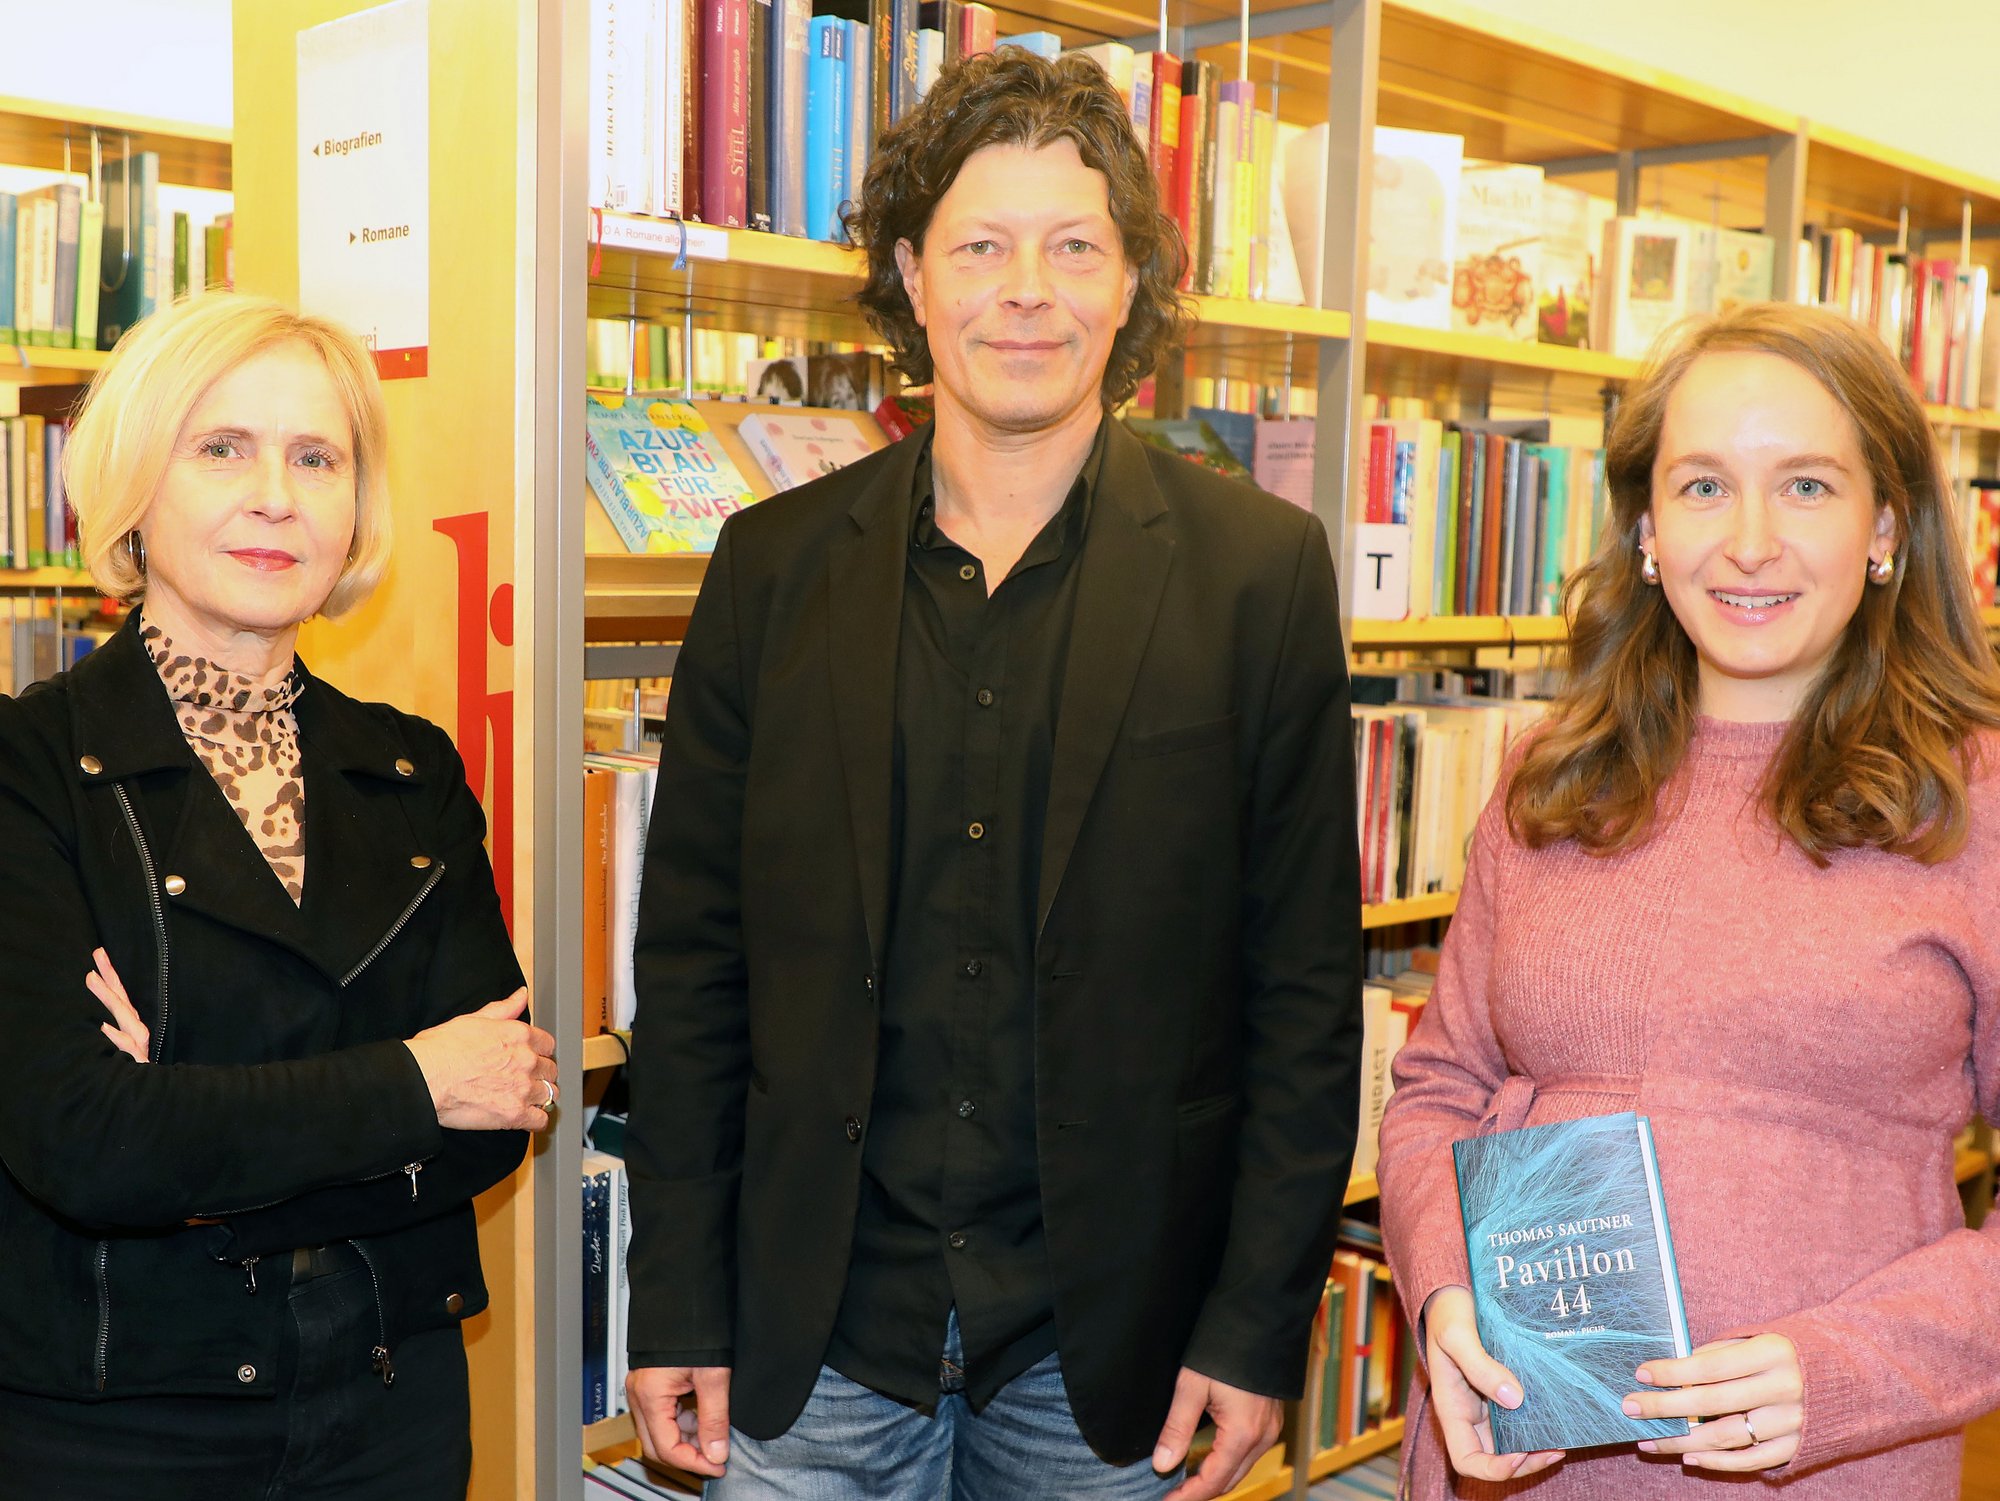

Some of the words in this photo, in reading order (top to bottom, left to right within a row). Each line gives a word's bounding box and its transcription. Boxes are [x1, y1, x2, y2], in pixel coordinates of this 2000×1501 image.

[324, 131, 382, 156] Biografien
[731, 124, 744, 177] STEEL
[362, 224, 410, 243] Romane
[614, 227, 621, 236] A
[626, 228, 663, 242] Romane
[665, 235, 706, 248] allgmein
[618, 429, 706, 451] AZUR
[630, 453, 717, 474] BLAU
[658, 476, 717, 497] FÜR
[609, 478, 649, 539] AZURBLAU
[661, 495, 743, 519] ZWEI
[1367, 553, 1392, 590] T
[636, 861, 644, 884] Die
[1487, 1225, 1554, 1248] THOMAS
[1558, 1214, 1633, 1236] SAUTNER
[1495, 1243, 1636, 1289] Pavillon
[1550, 1283, 1592, 1318] 44
[1545, 1329, 1576, 1340] ROMAN
[1582, 1325, 1605, 1336] PICUS
